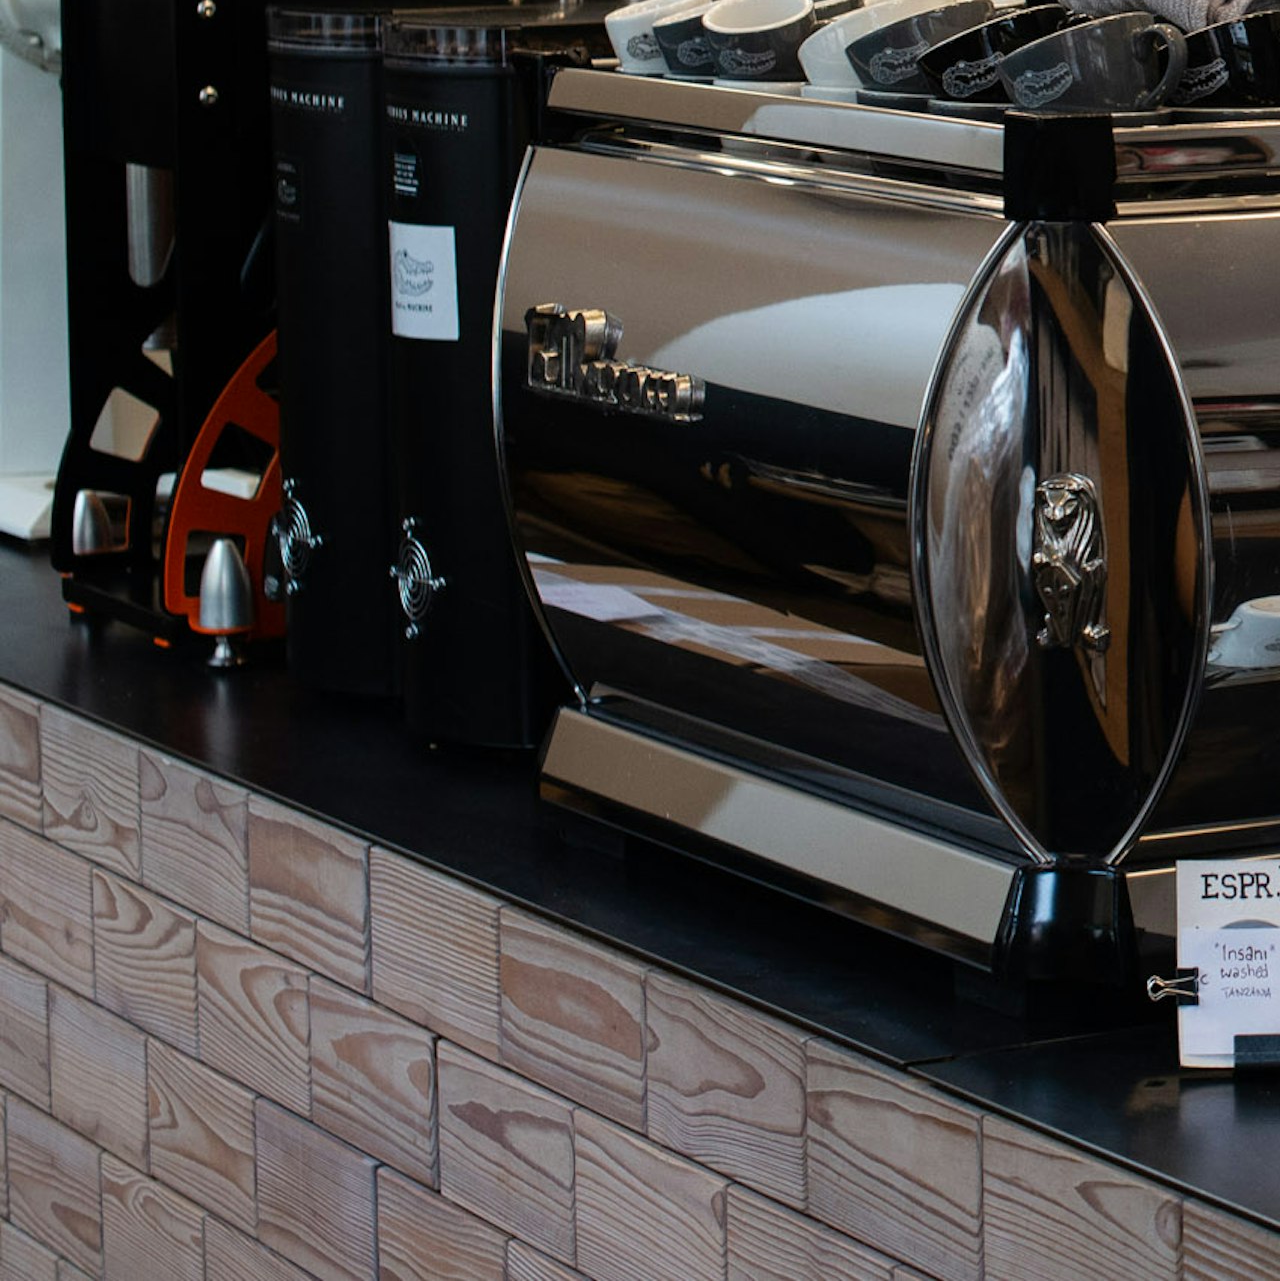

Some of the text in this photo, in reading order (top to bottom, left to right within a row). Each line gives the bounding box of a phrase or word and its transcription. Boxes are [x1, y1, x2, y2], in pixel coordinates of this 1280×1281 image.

[291, 90, 345, 109] MACHINE
[411, 108, 468, 128] MACHINE
[1220, 963, 1269, 979] washed
